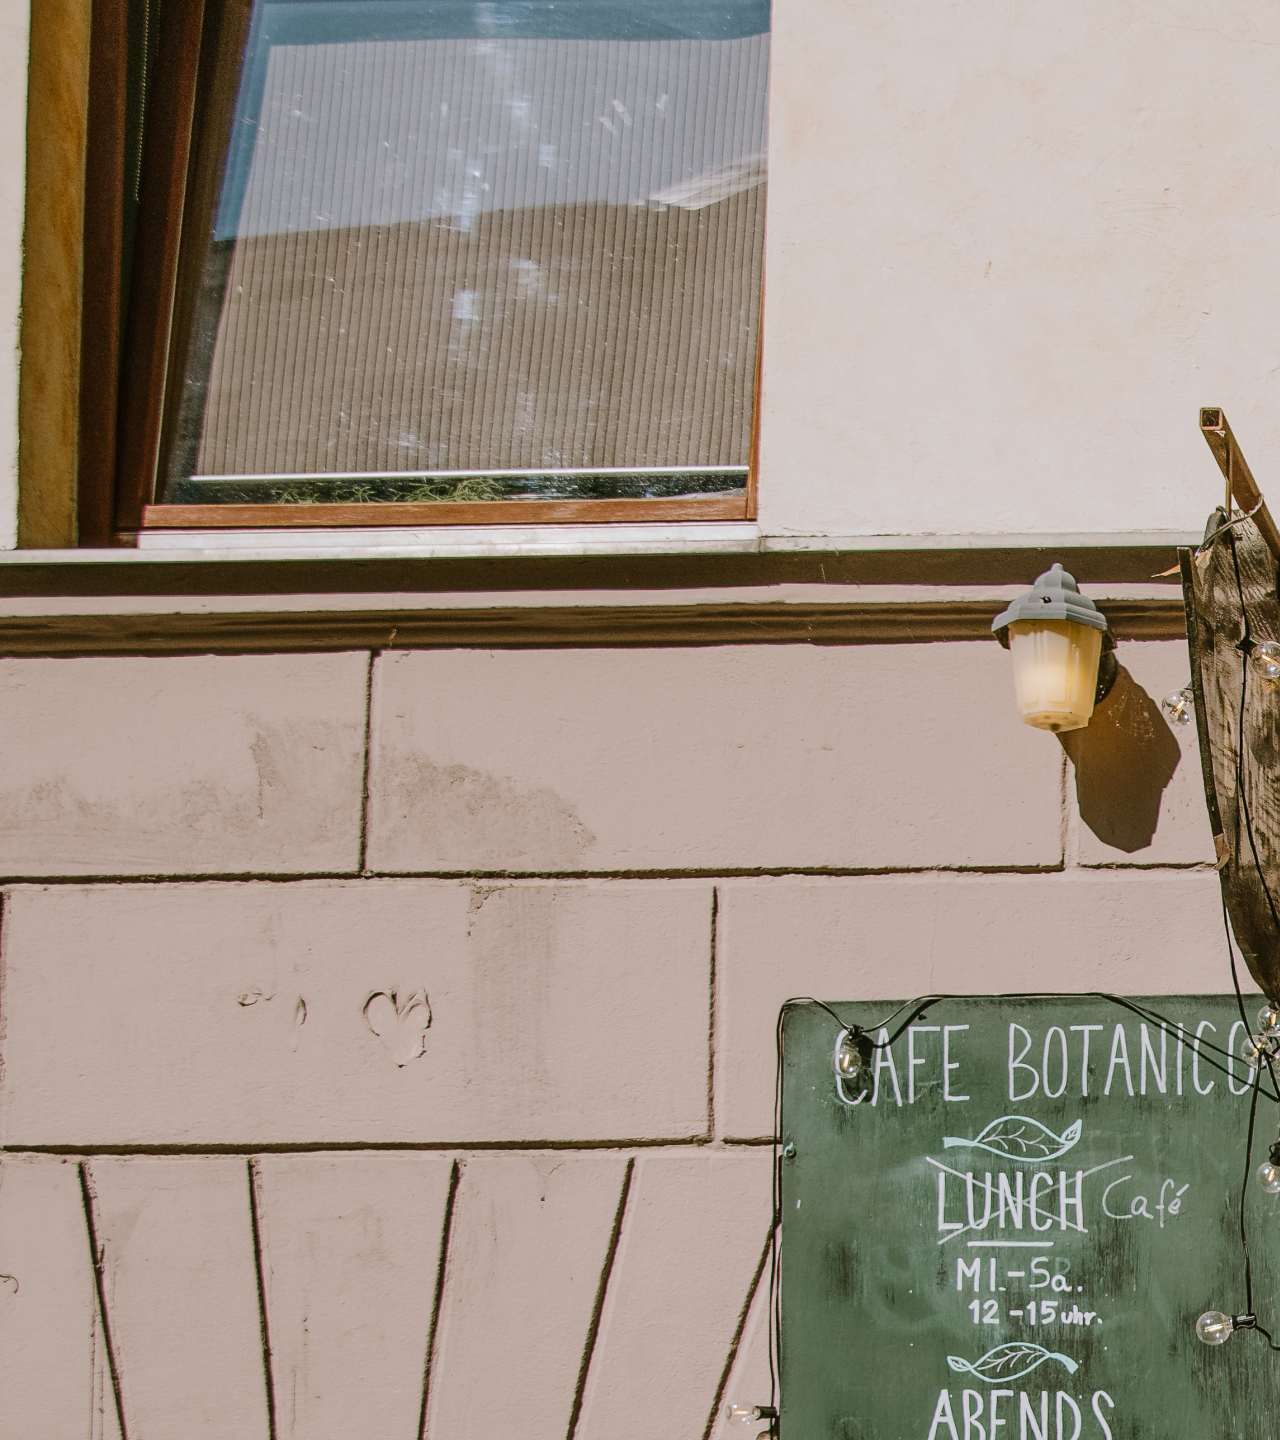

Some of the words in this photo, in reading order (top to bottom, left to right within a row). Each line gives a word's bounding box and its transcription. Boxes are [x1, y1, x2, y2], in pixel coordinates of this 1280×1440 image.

[832, 1023, 970, 1107] CAFE
[1008, 1019, 1258, 1102] BOTANICO
[937, 1168, 1086, 1233] LUNCH
[1101, 1175, 1191, 1229] Café
